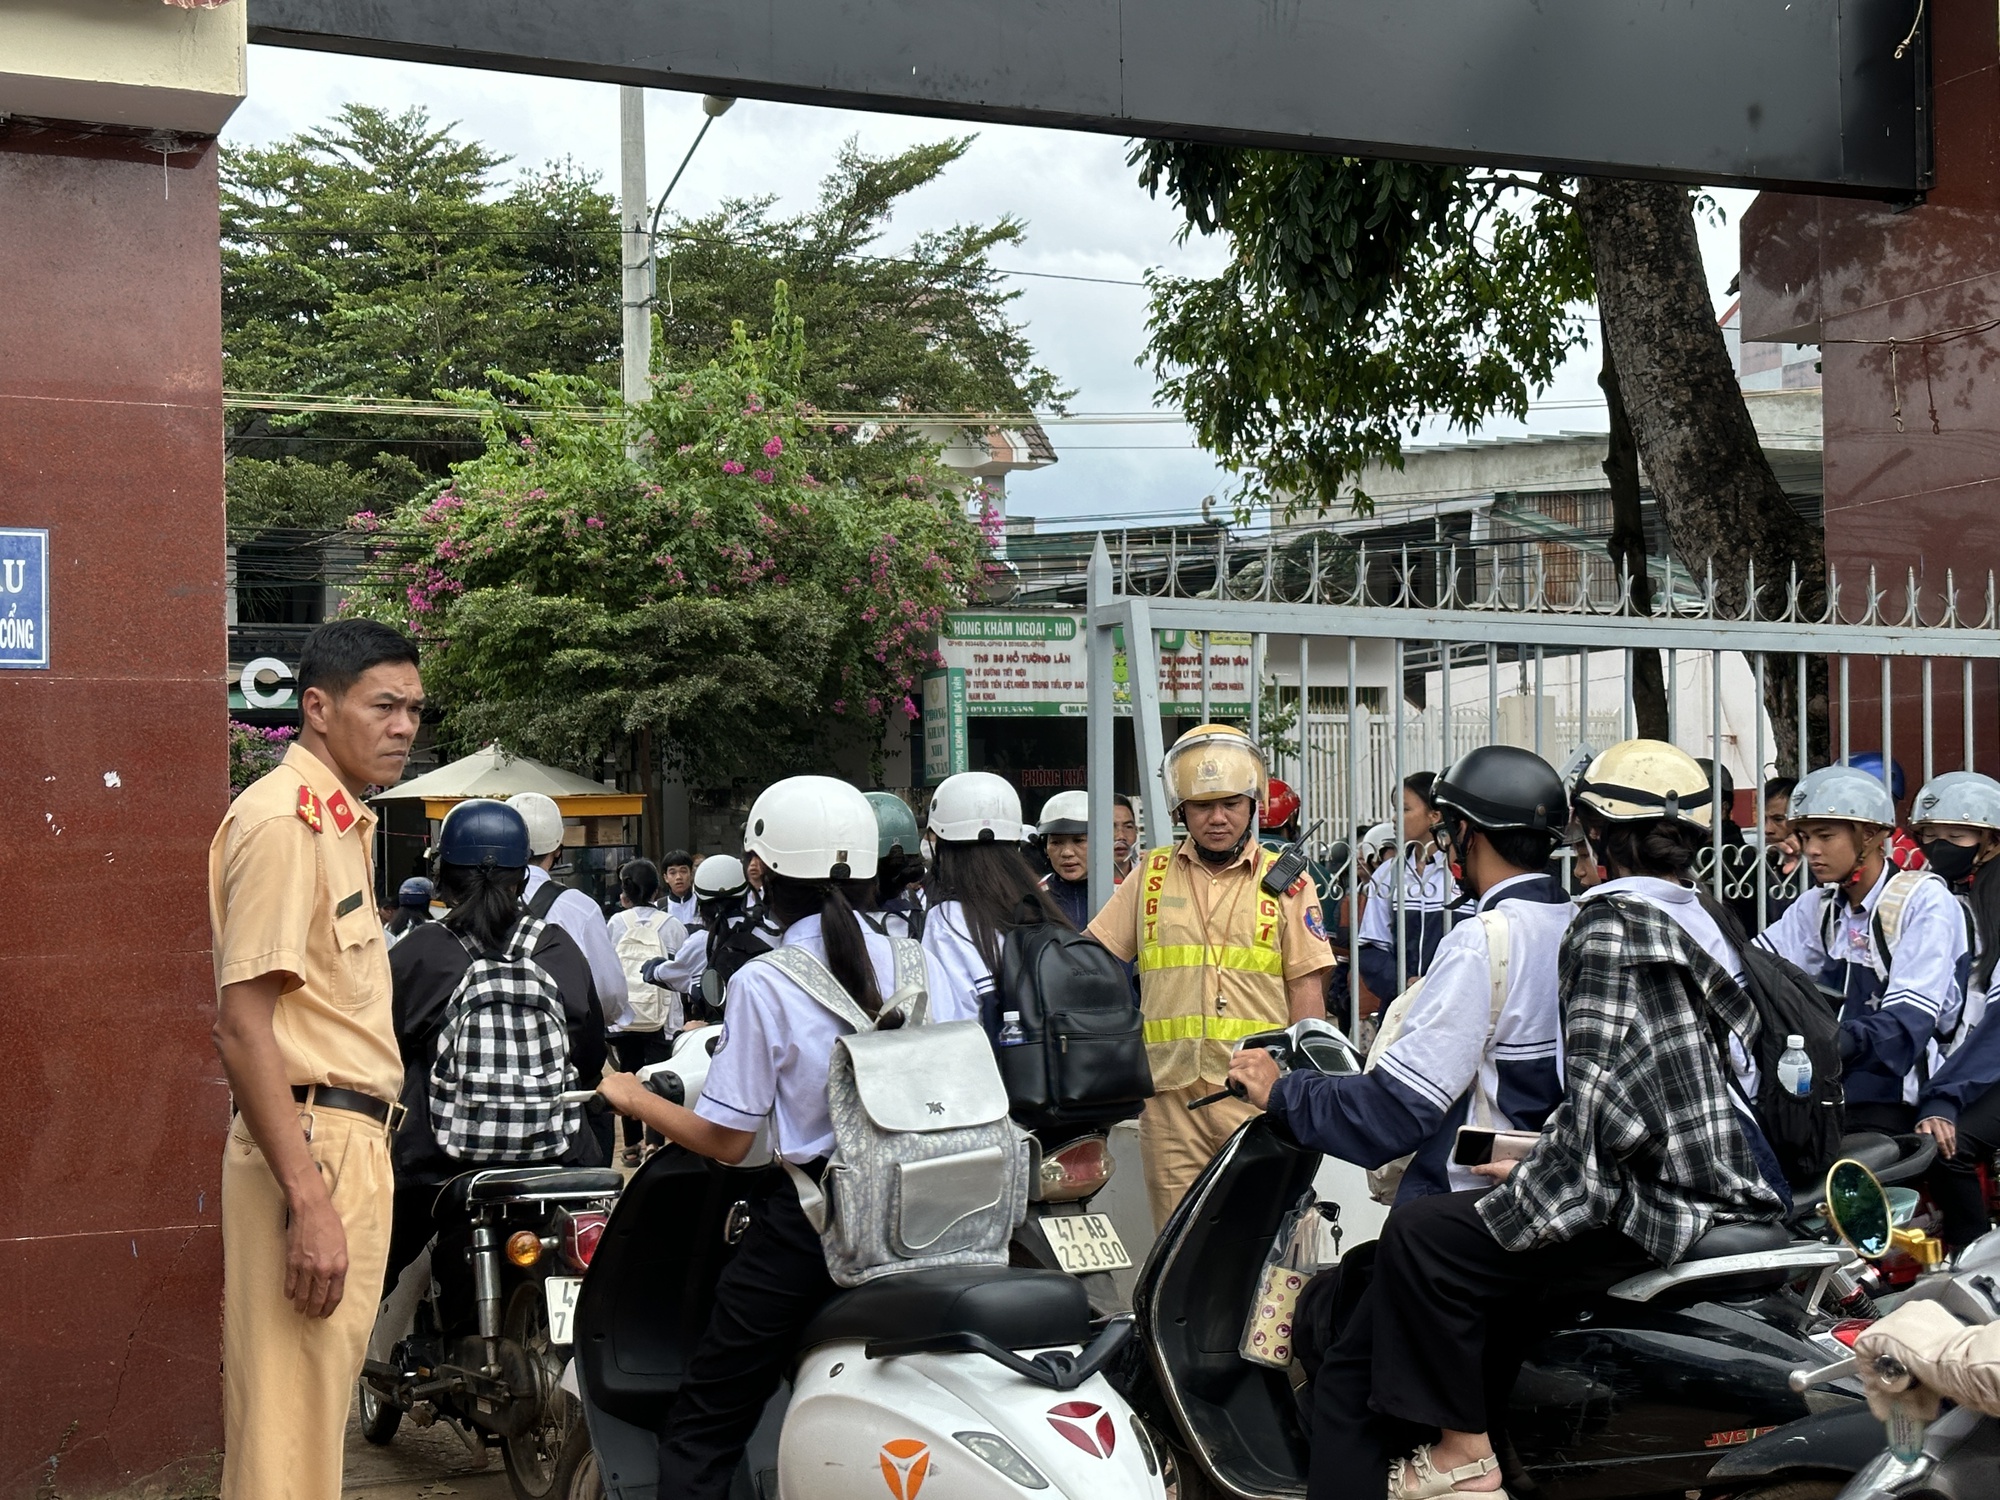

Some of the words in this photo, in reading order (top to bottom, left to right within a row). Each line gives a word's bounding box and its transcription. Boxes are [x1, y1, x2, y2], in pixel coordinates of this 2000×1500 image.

[0, 559, 26, 594] U
[0, 602, 34, 650] CỔNG
[953, 617, 981, 636] HÒNG
[1055, 622, 1072, 637] NHI
[1174, 653, 1202, 666] NGUYỄ
[1063, 766, 1087, 787] KHÁ
[1146, 855, 1168, 940] CSGT
[1058, 1241, 1128, 1269] 233.90
[562, 1281, 582, 1308] 4
